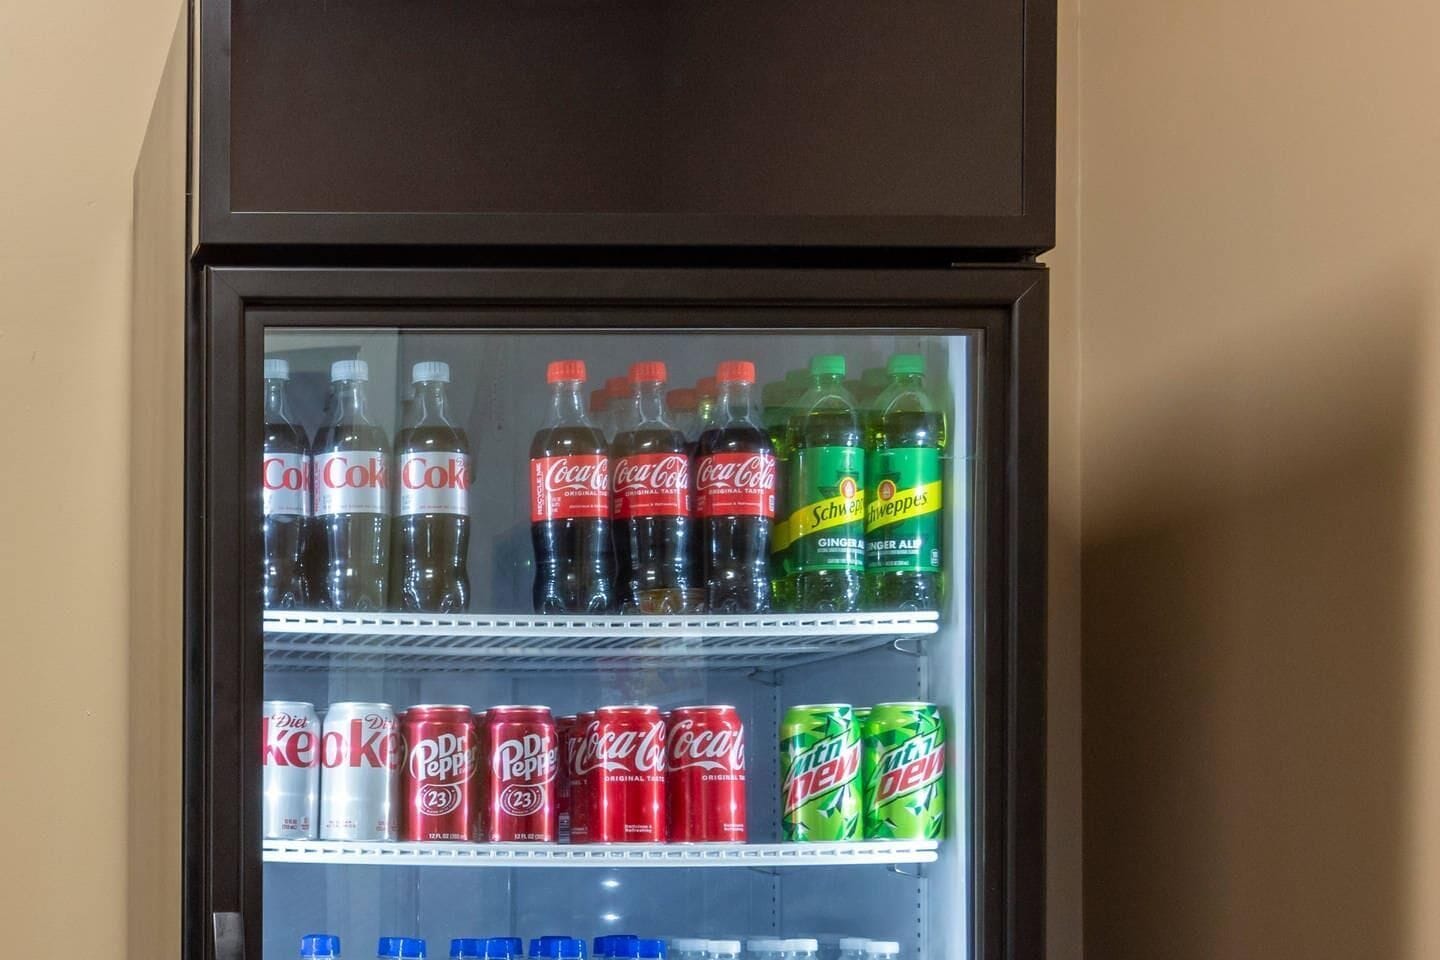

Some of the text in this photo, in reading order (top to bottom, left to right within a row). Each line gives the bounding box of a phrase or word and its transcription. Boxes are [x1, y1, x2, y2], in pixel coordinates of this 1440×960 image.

[697, 455, 775, 492] Coca-Cola
[564, 490, 598, 498] ORIGINAL
[625, 488, 660, 497] ORIGINAL
[708, 488, 742, 496] ORIGINAL
[272, 712, 308, 728] Diet
[438, 733, 467, 758] Dr
[523, 733, 551, 758] Dr
[604, 775, 644, 783] ORIGINAL
[428, 790, 447, 807] 23
[513, 790, 532, 807] 23
